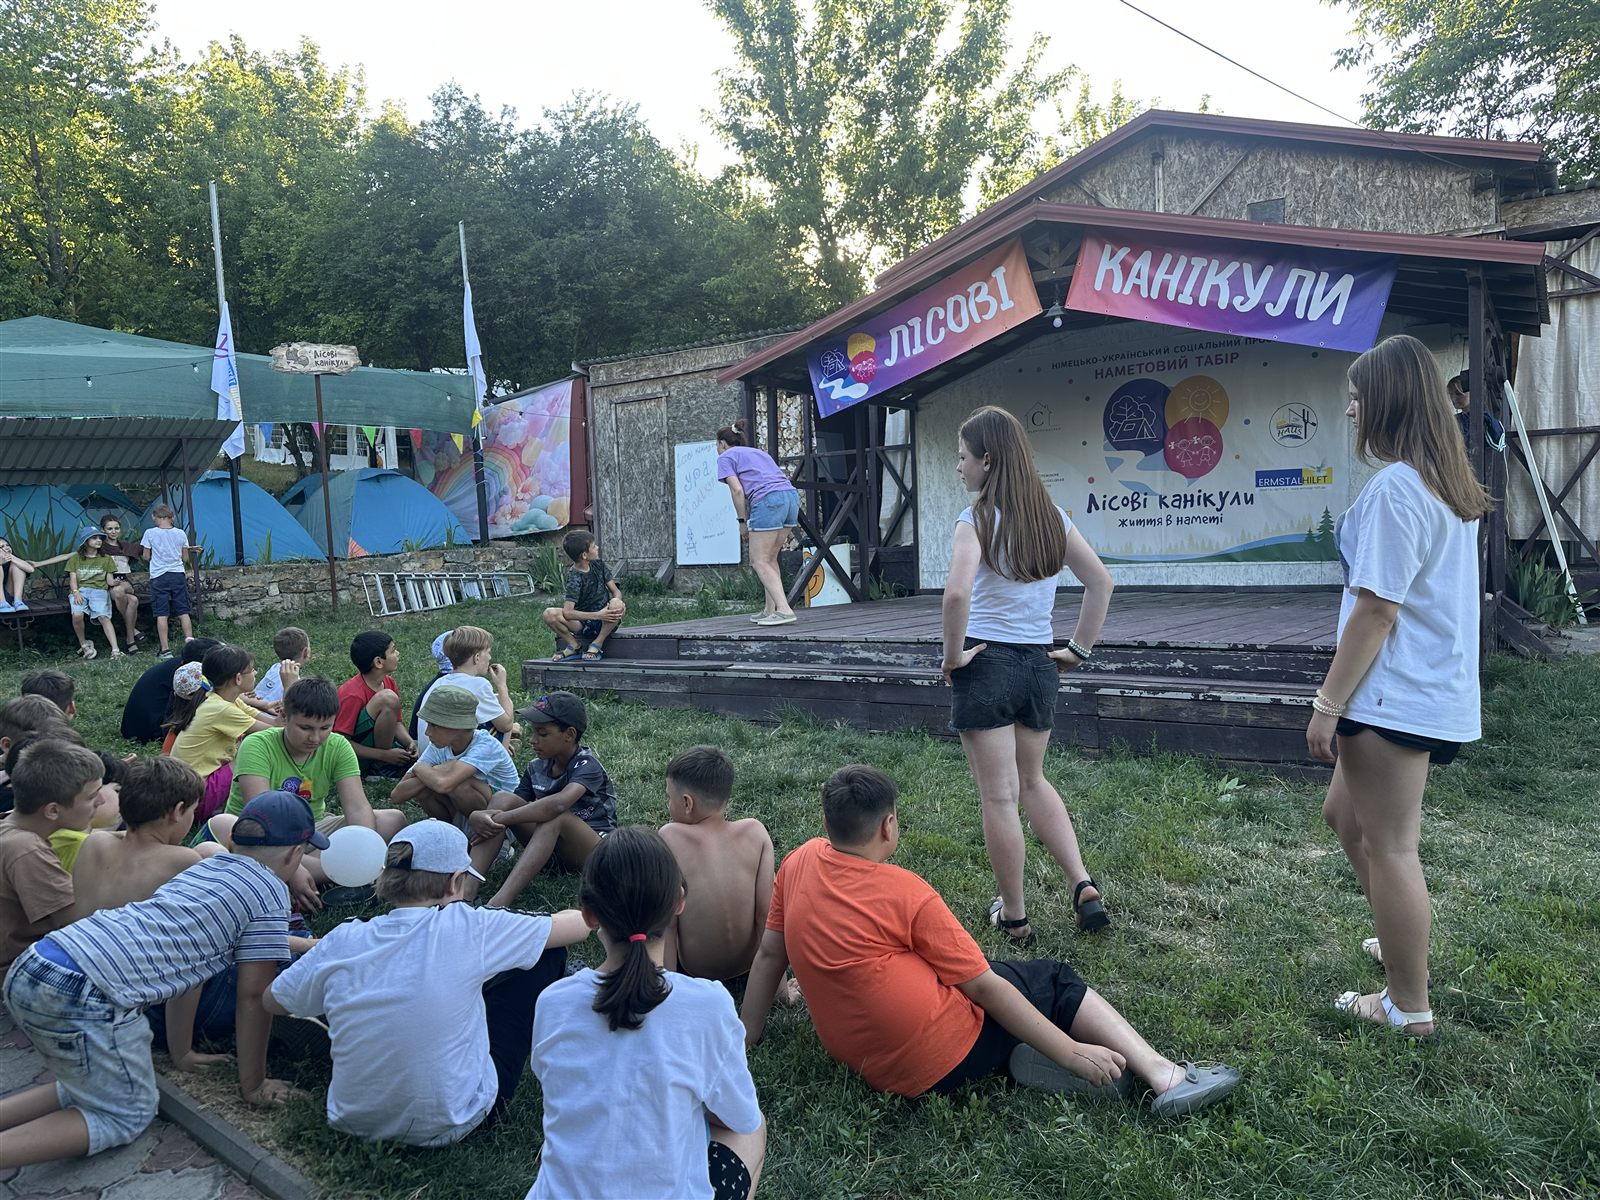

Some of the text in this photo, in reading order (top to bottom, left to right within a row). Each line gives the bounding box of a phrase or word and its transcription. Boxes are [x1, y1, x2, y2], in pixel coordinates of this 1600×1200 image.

[1094, 243, 1355, 326] КАНІКУЛИ
[884, 265, 1015, 367] ЛІСОВІ
[1051, 346, 1171, 369] НІМЕЦЬКО-УКРАЇНСЬКИЙ
[1173, 337, 1241, 354] СОЦІАЛЬНИЙ
[1094, 351, 1240, 380] НАМЕТОВИЙ ТАБІР
[1086, 489, 1255, 514] Лісові канікули
[1118, 517, 1163, 528] життя
[1176, 513, 1224, 526] наметі
